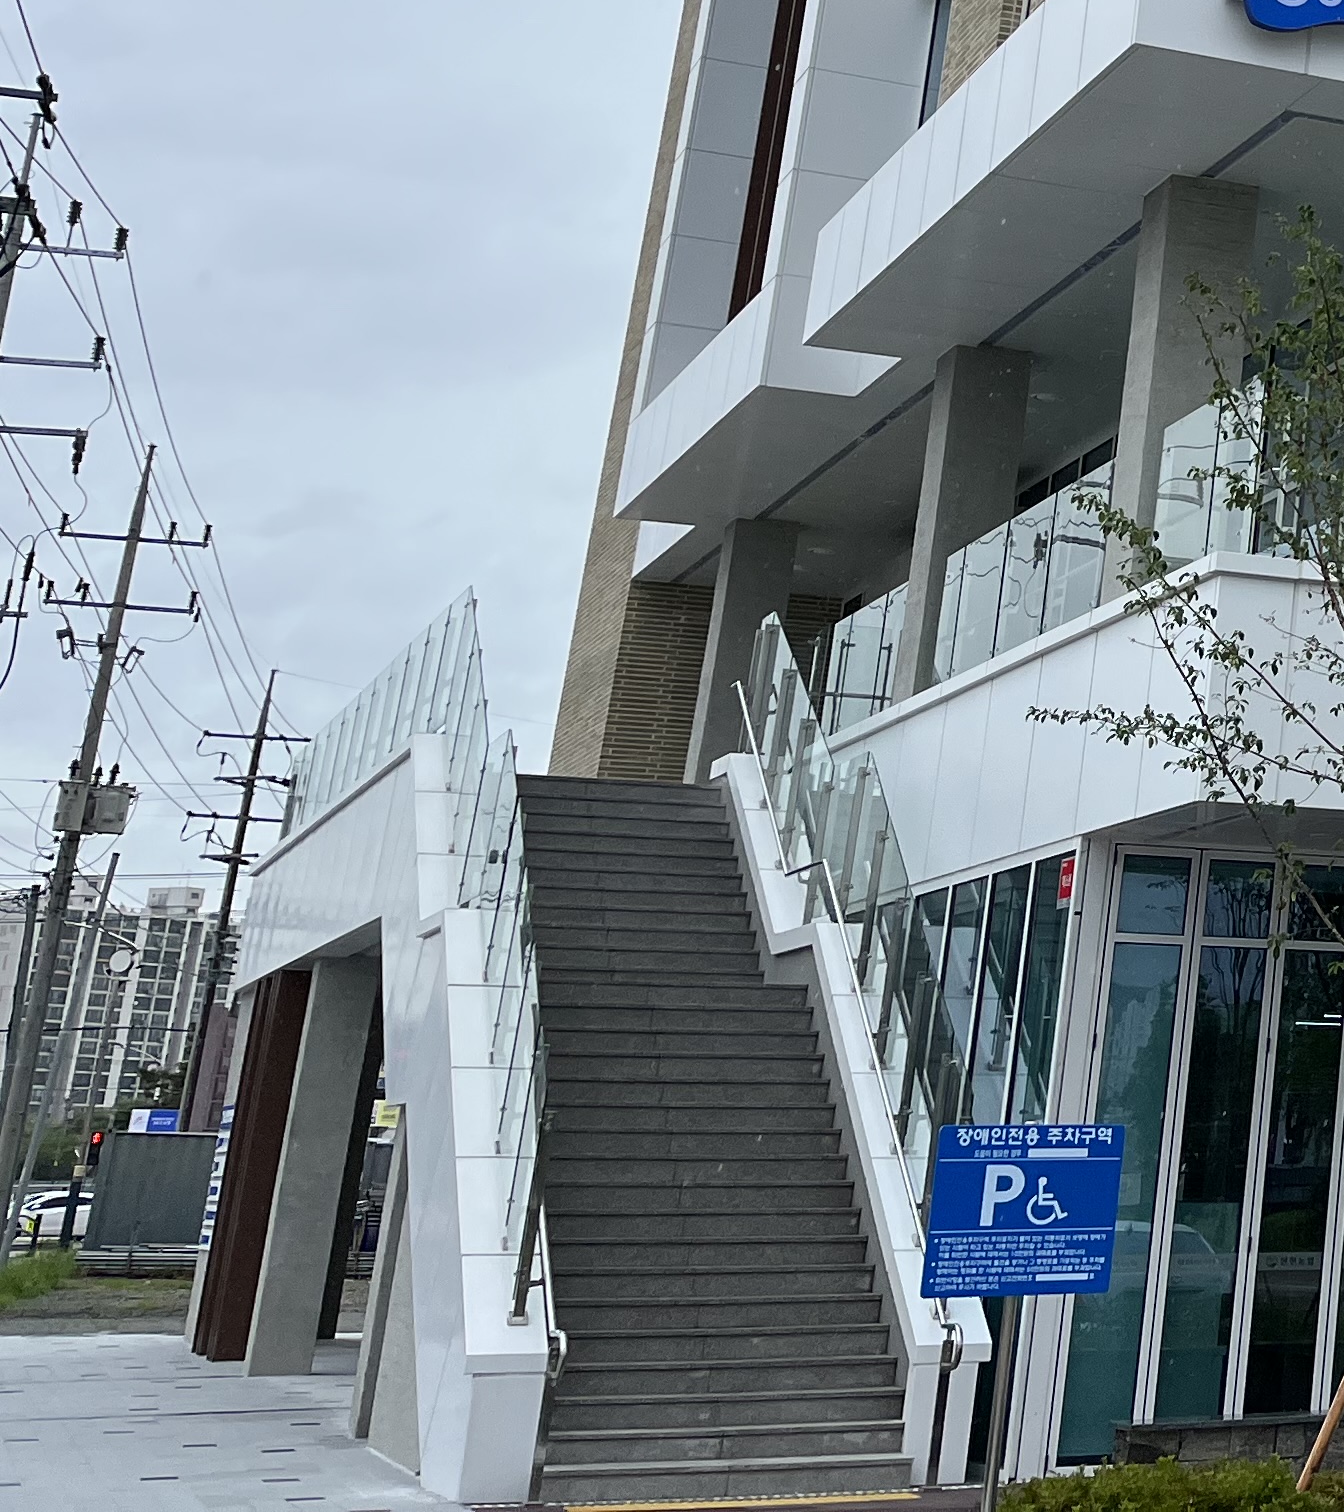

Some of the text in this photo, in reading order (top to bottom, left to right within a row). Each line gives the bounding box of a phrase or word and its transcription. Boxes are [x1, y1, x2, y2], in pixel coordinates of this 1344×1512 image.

[956, 1127, 1113, 1146] 장애인전용 주차구역
[979, 1164, 1025, 1226] P
